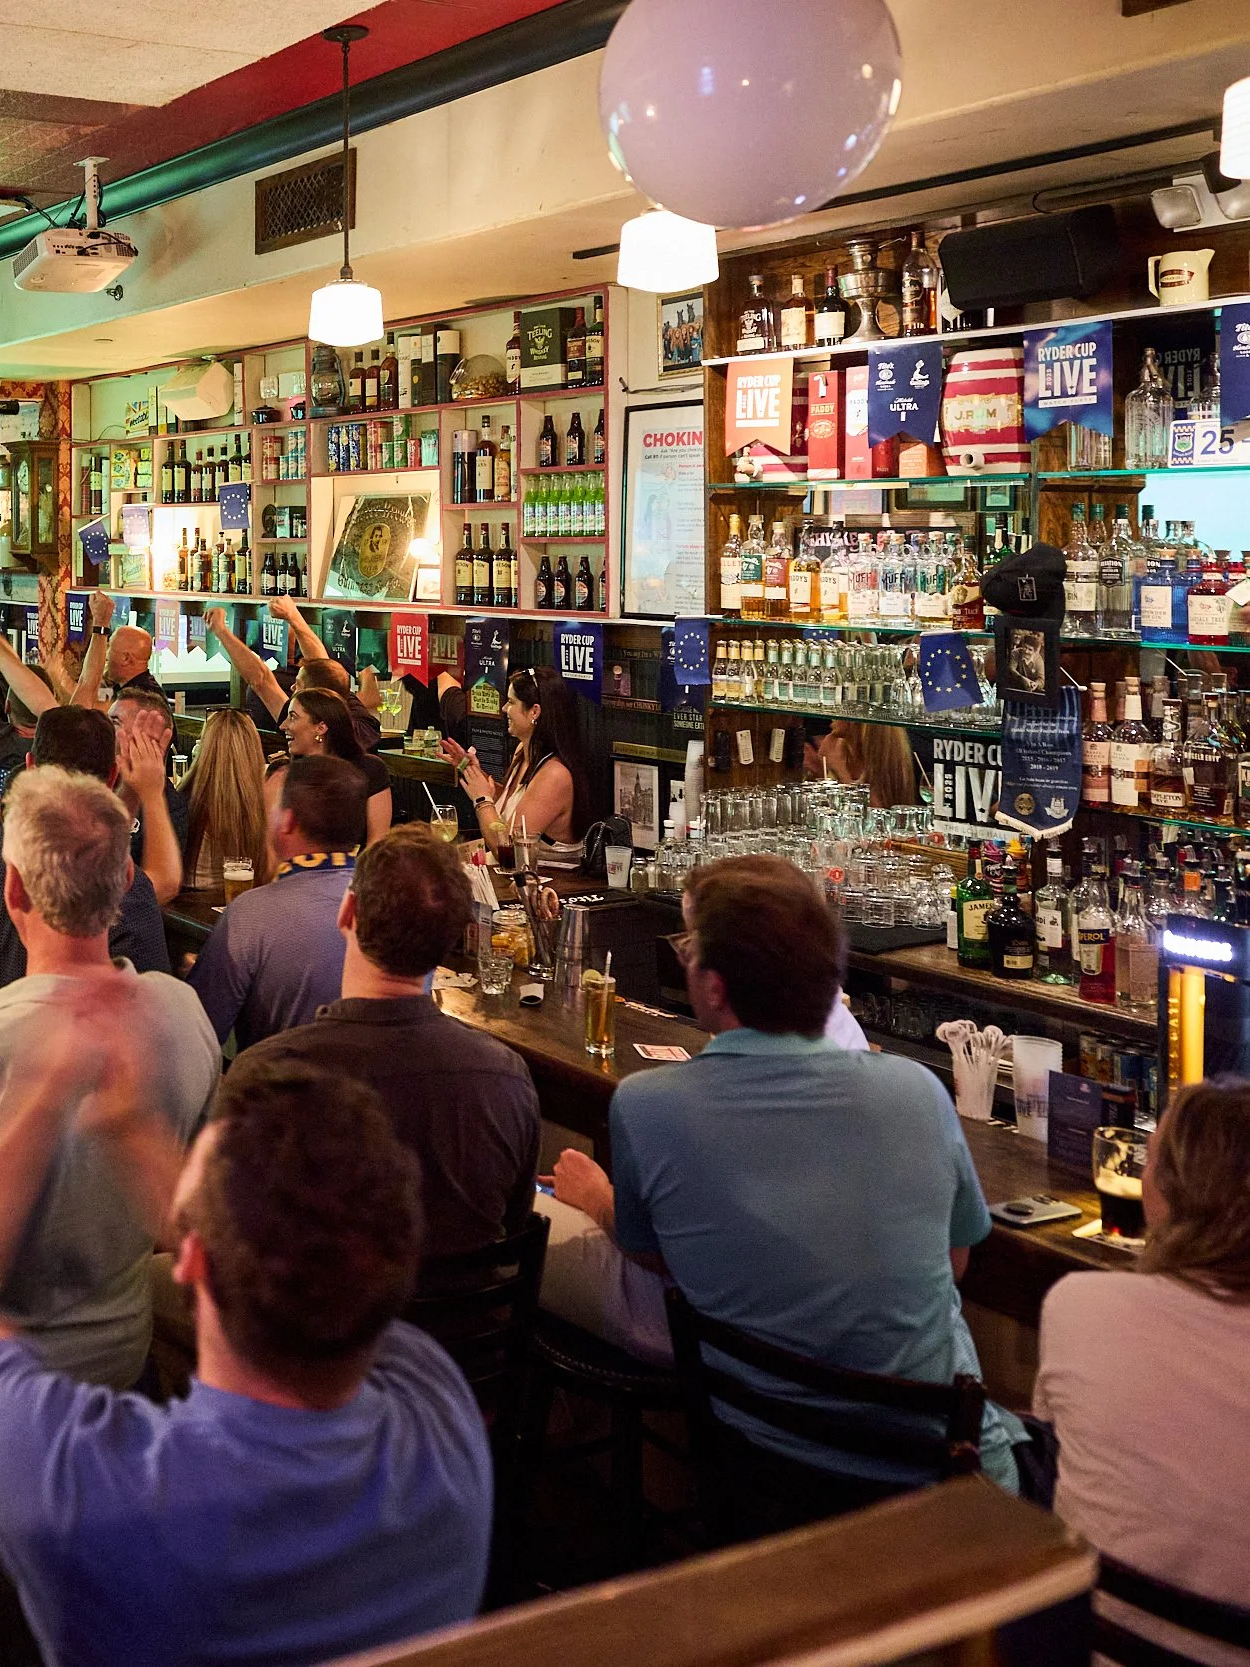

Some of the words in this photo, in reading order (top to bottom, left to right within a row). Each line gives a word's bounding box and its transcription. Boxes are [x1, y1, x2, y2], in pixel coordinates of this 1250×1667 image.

[527, 328, 552, 341] TEELING
[1038, 344, 1074, 361] RYDER
[1076, 341, 1097, 357] CUP
[1038, 358, 1097, 398] LIVE
[736, 388, 780, 419] LIVE
[811, 405, 835, 414] PADDY
[889, 403, 919, 412] ULTRA
[955, 408, 997, 420] J.RM
[643, 431, 703, 448] CHOKIN
[1201, 429, 1234, 455] 25
[70, 609, 83, 627] LIVE
[263, 623, 284, 646] LIVE
[397, 625, 412, 635] RYDER
[412, 626, 422, 636] CUP
[397, 635, 422, 659] LIVE
[561, 634, 581, 645] RYDER
[581, 636, 594, 646] CUP
[561, 645, 593, 673] LIVE
[673, 711, 688, 720] EVER
[688, 713, 704, 722] STAR
[933, 738, 985, 764] RYDER
[987, 745, 1003, 767] CU
[933, 763, 1002, 823] LIV
[944, 824, 960, 833] THE
[968, 902, 993, 911] JAMES
